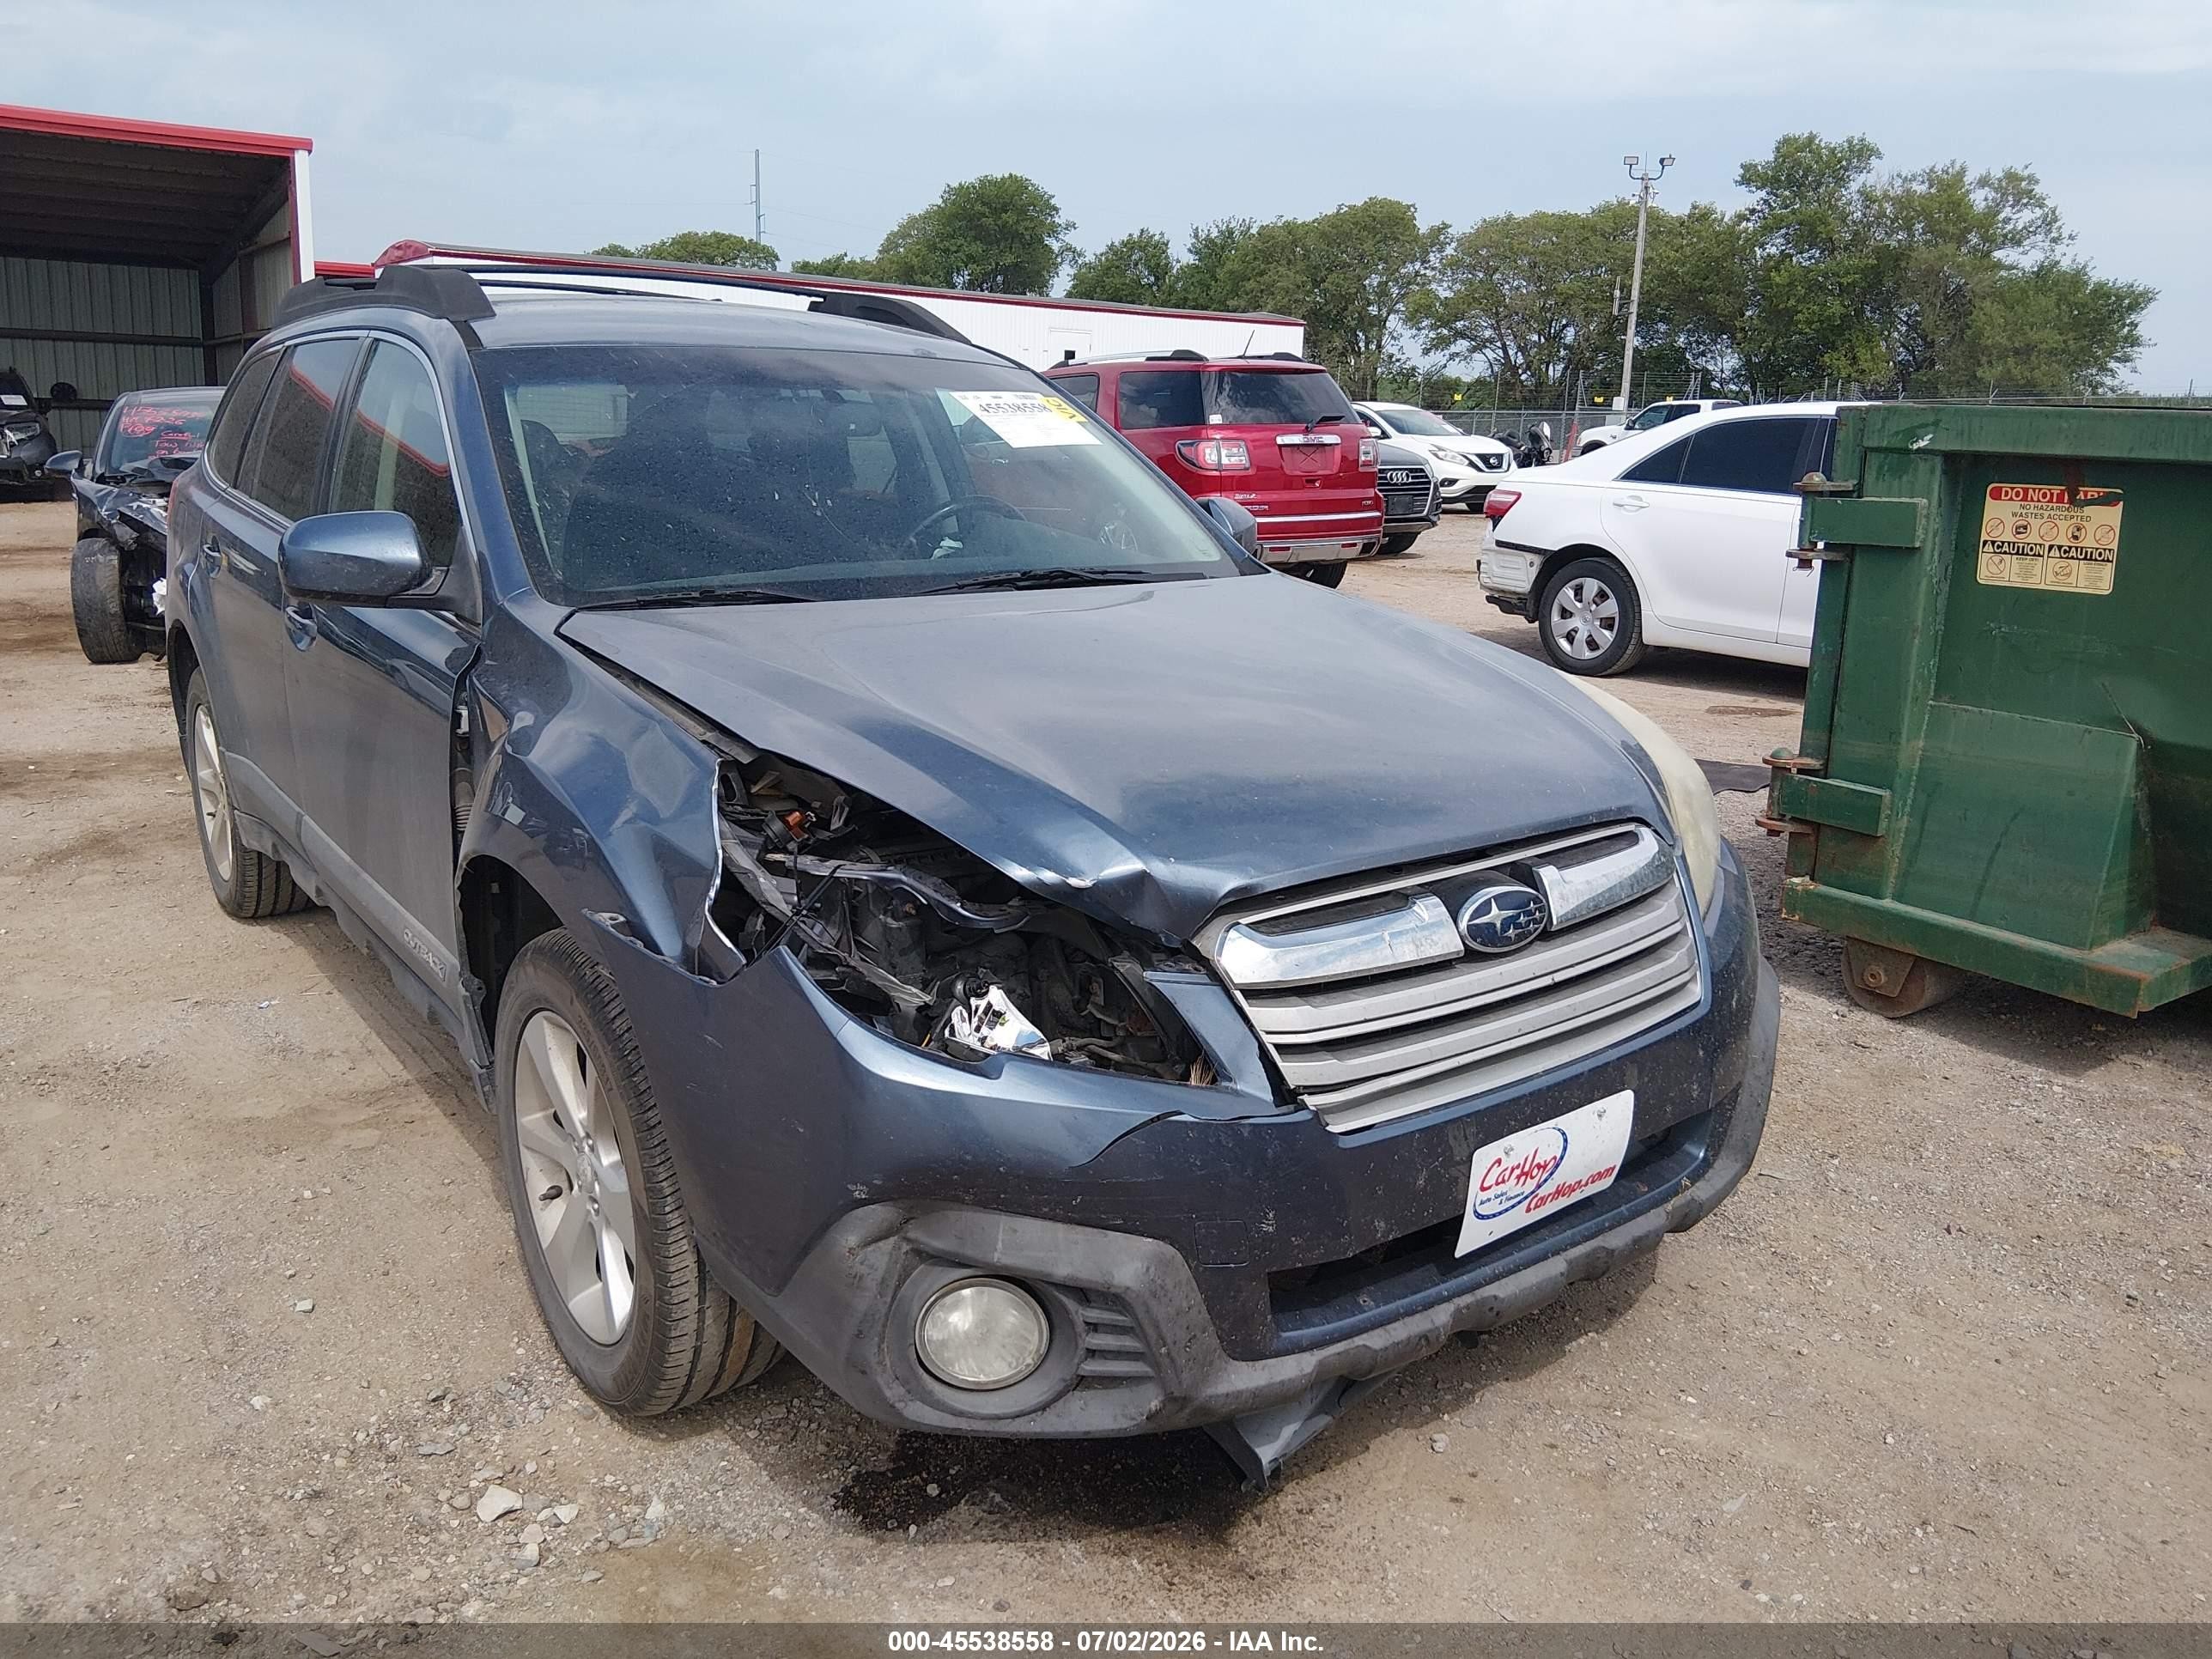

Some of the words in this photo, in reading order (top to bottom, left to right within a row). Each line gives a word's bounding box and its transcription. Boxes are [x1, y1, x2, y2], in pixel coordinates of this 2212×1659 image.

[979, 403, 1054, 414] 45538558
[2001, 487, 2023, 501] DO
[2027, 488, 2060, 502] NOT
[2011, 511, 2045, 520] WASTES
[2047, 514, 2092, 522] ACCEPTED
[2033, 504, 2085, 514] HAZARDOUS
[1994, 541, 2045, 556] CAUTION
[2061, 546, 2114, 561] CAUTION
[1480, 1146, 1558, 1192] CarHop
[1525, 1164, 1617, 1213] CarHop.com
[1479, 1198, 1492, 1206] Auto
